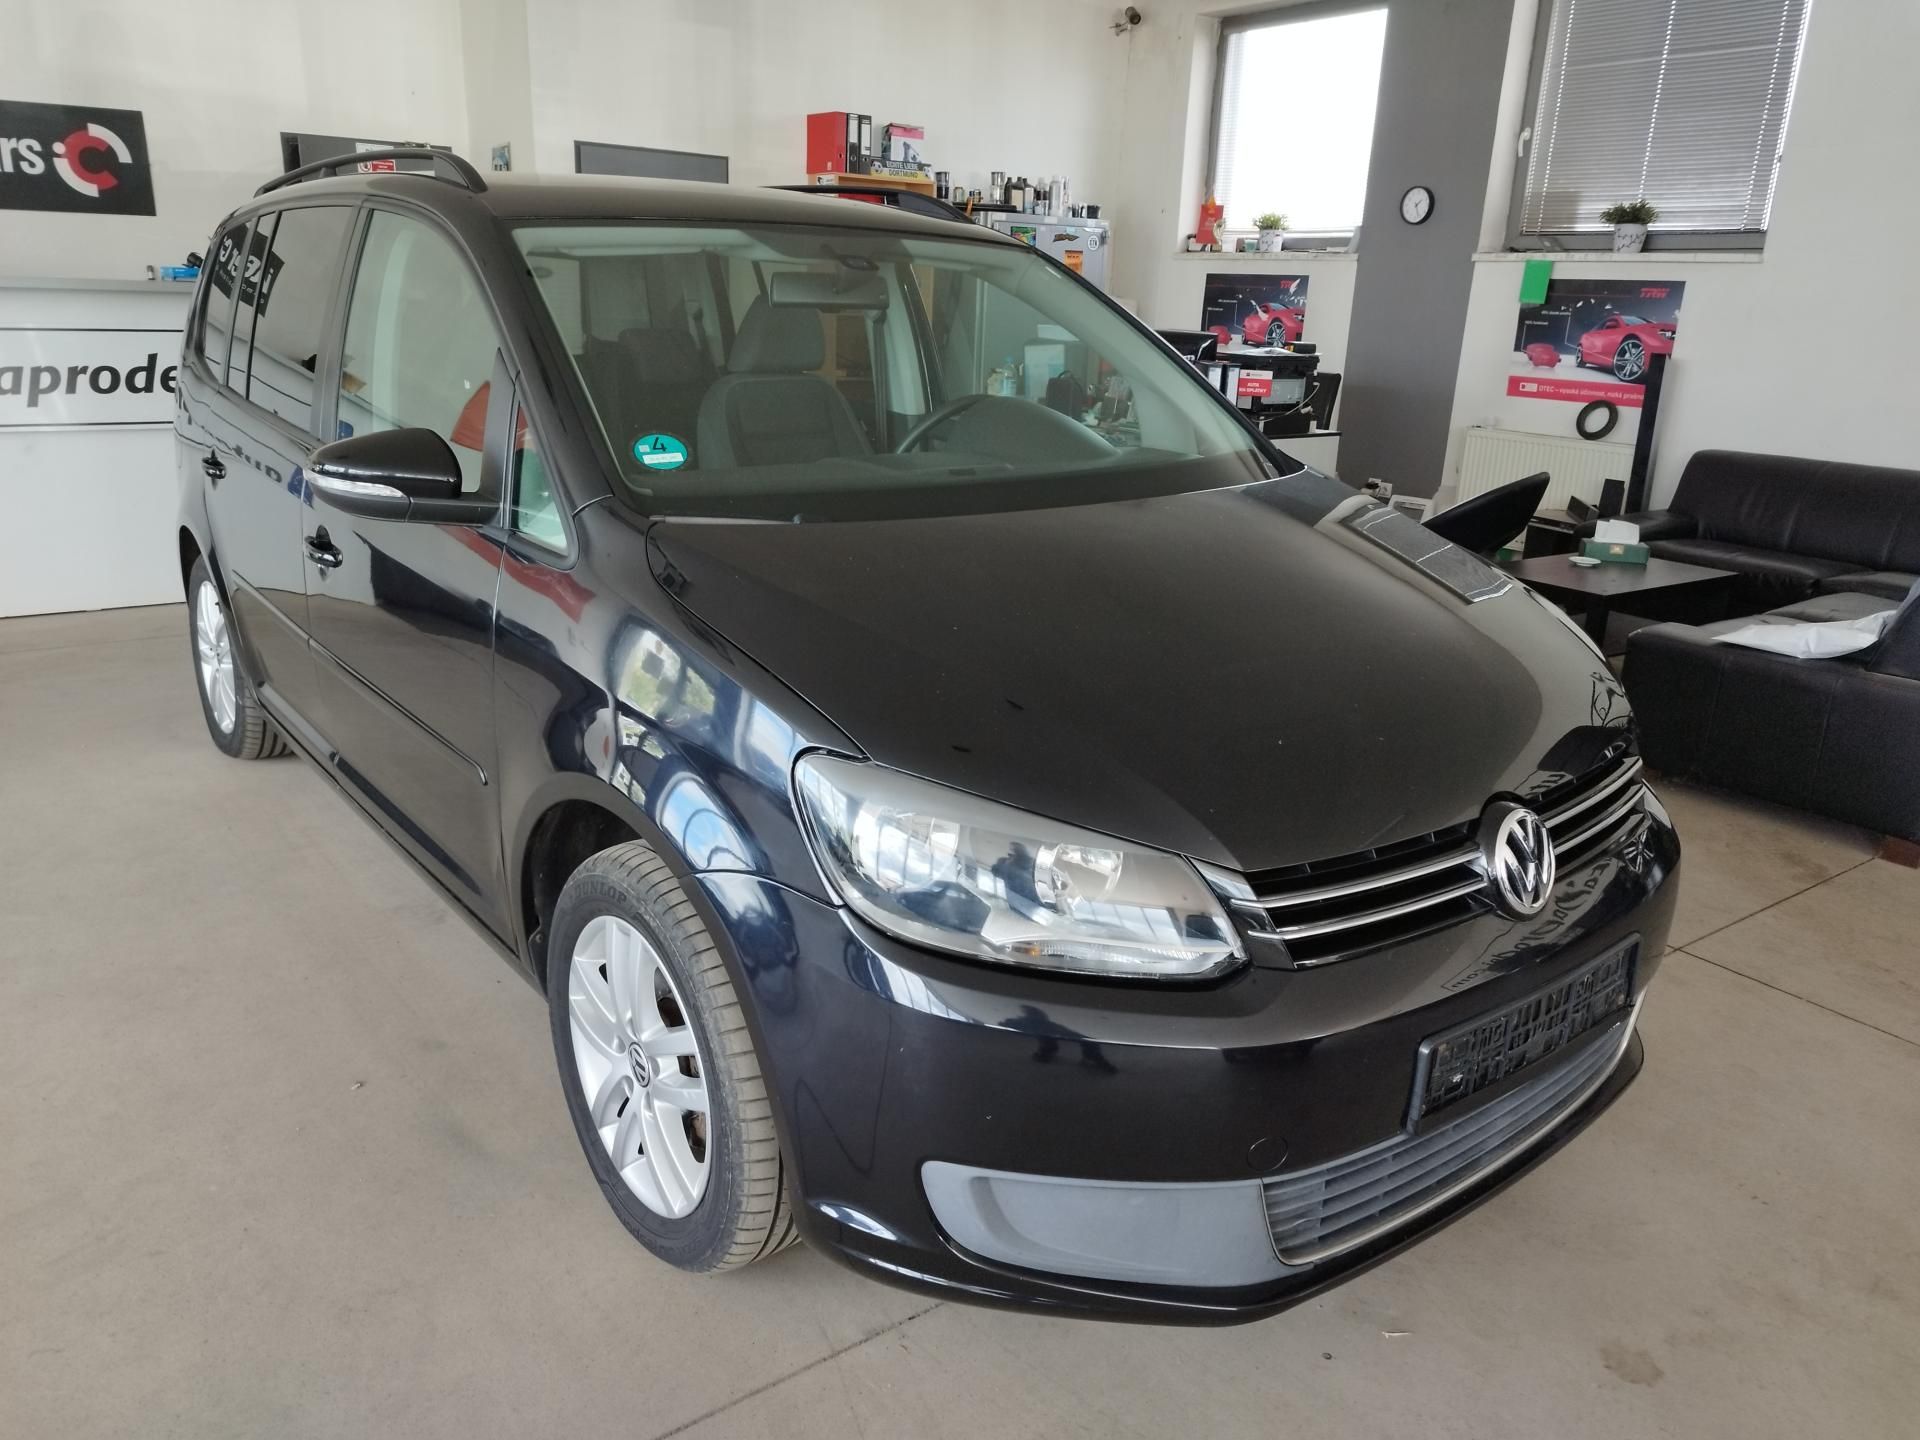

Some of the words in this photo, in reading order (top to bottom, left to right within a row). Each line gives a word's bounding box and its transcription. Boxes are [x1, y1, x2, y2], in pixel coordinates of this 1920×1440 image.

[0, 138, 45, 175] rs
[652, 436, 667, 452] 4
[575, 880, 627, 904] DUNLOP
